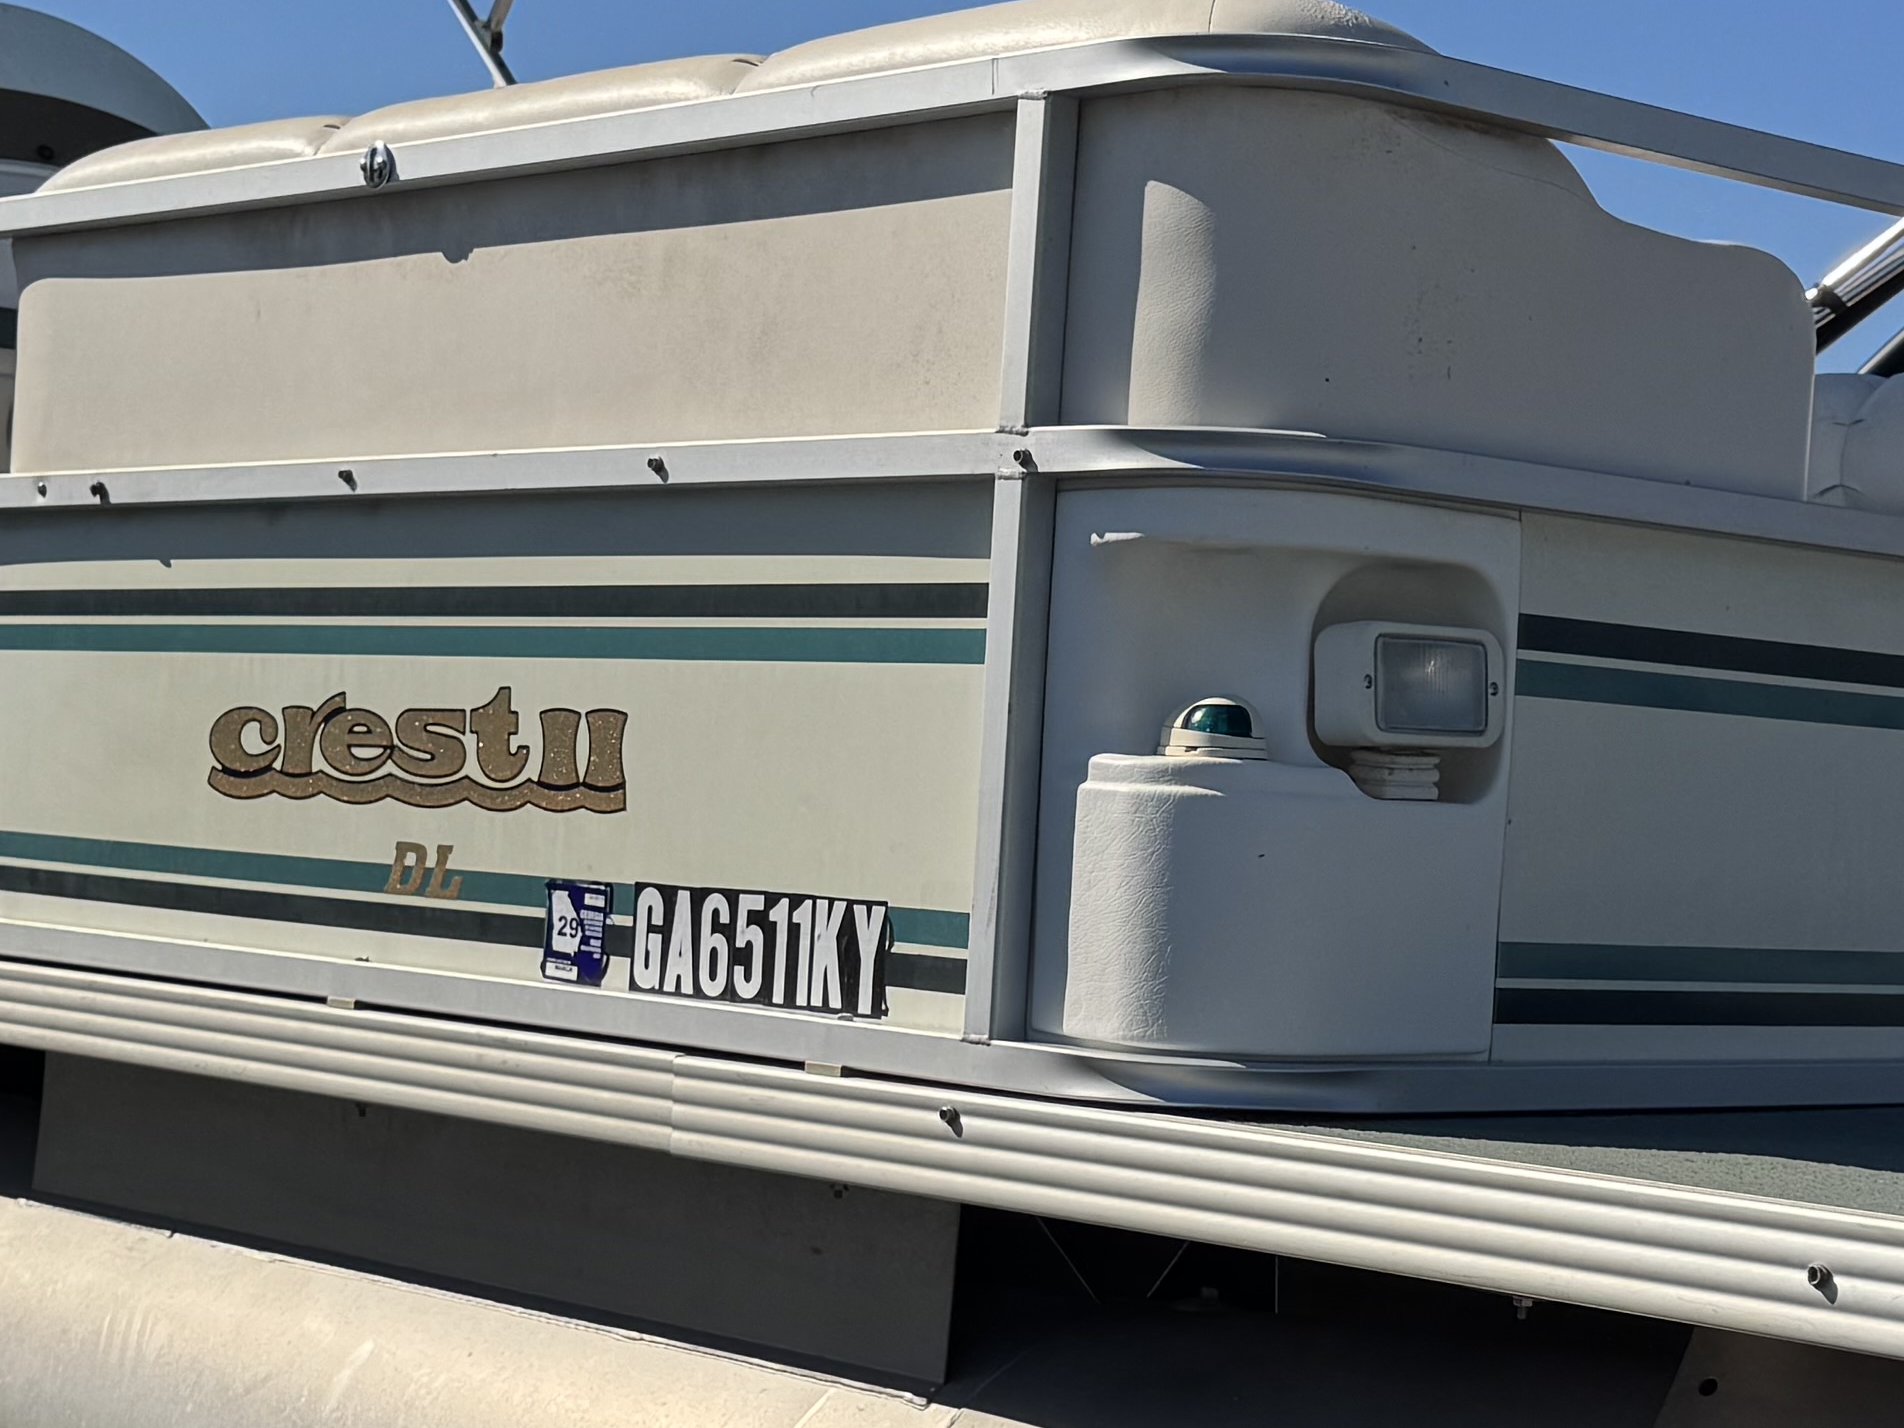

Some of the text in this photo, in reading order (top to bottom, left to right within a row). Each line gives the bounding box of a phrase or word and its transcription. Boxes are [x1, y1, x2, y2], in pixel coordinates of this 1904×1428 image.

[209, 686, 530, 783] crest
[384, 841, 463, 900] DL
[556, 915, 580, 938] 29
[633, 887, 886, 1015] GA6511KY
